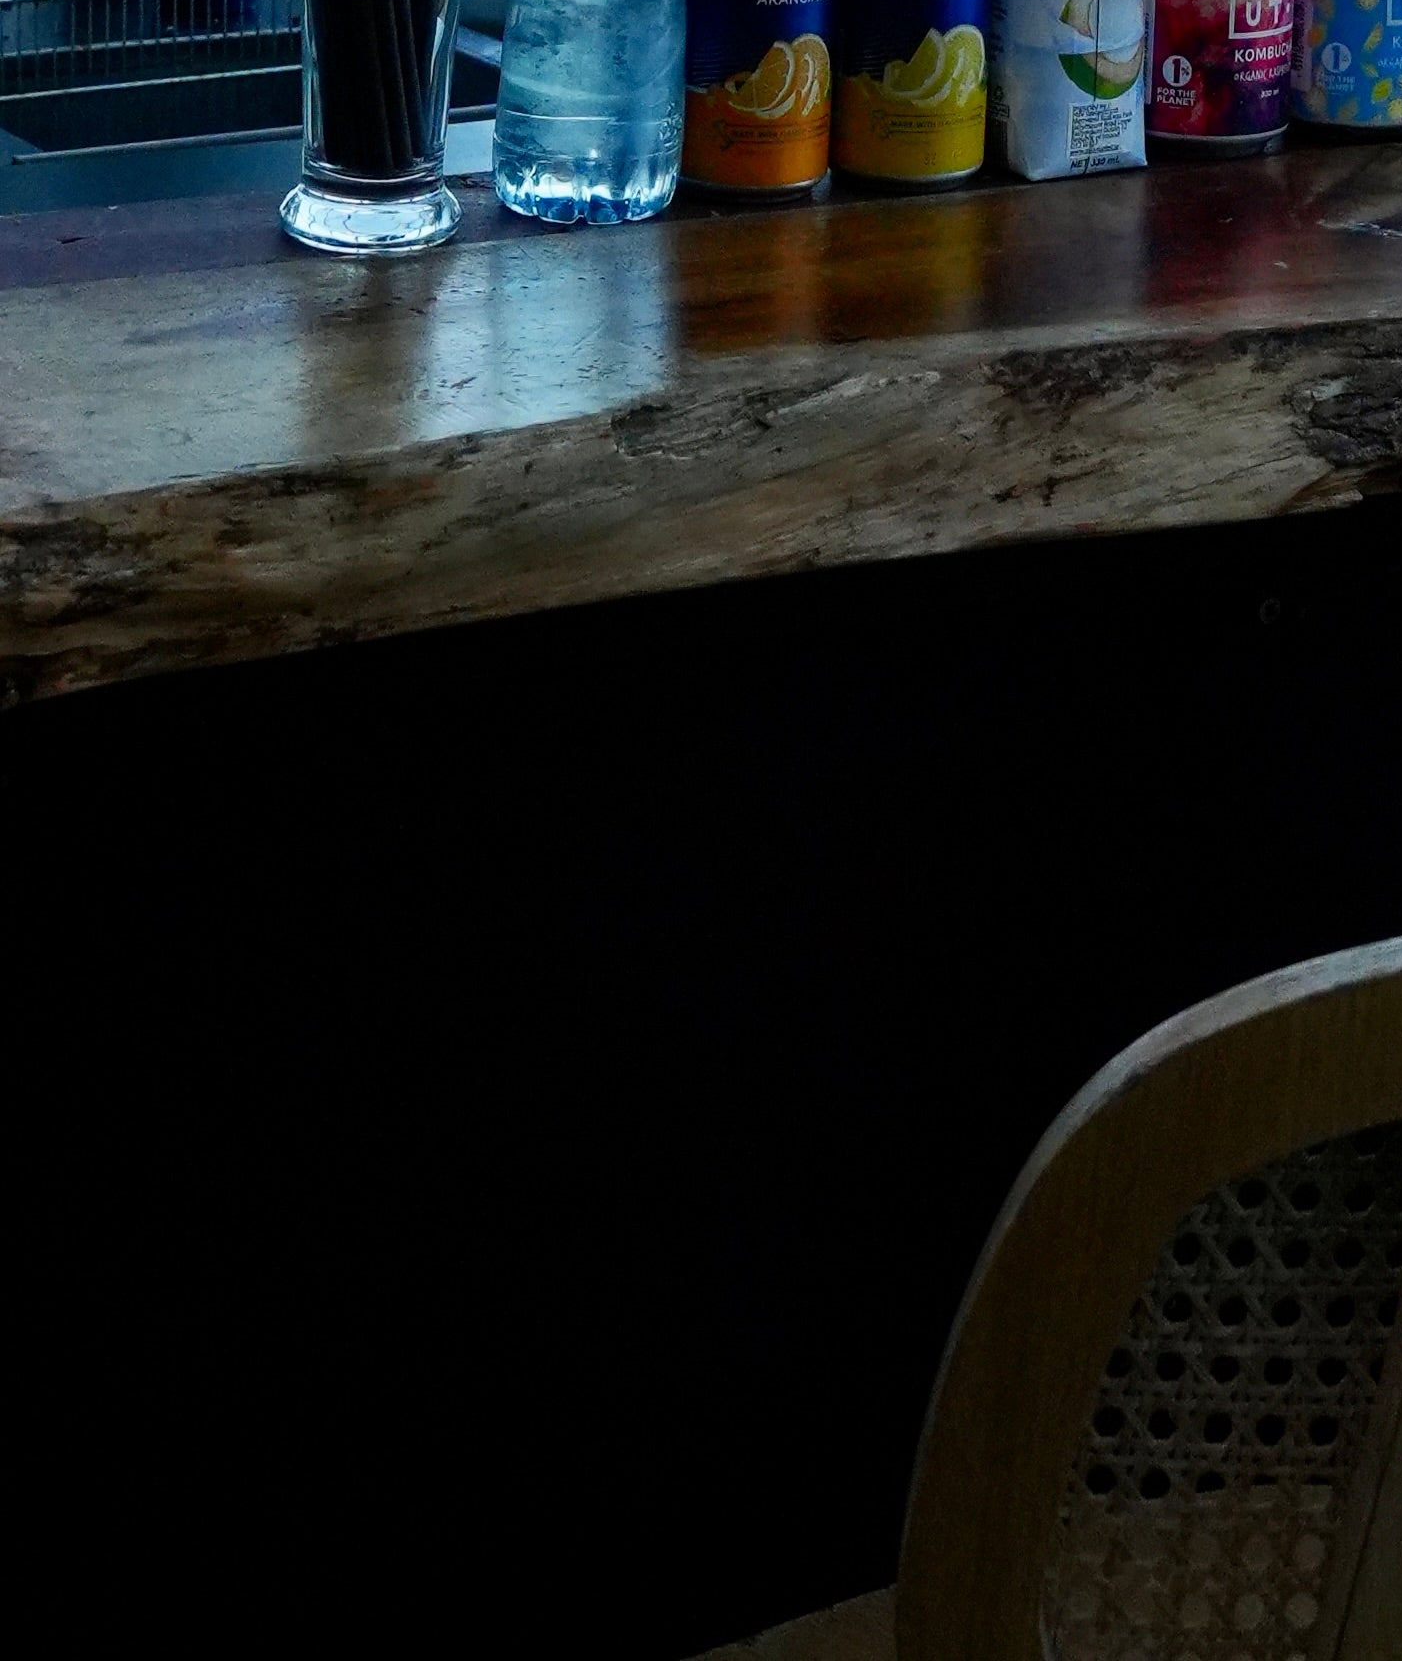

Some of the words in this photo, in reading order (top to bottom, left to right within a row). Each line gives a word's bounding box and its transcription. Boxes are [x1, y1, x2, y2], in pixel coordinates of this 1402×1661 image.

[1157, 87, 1176, 97] FOR
[1178, 88, 1196, 98] THE
[1157, 95, 1196, 106] PLANET
